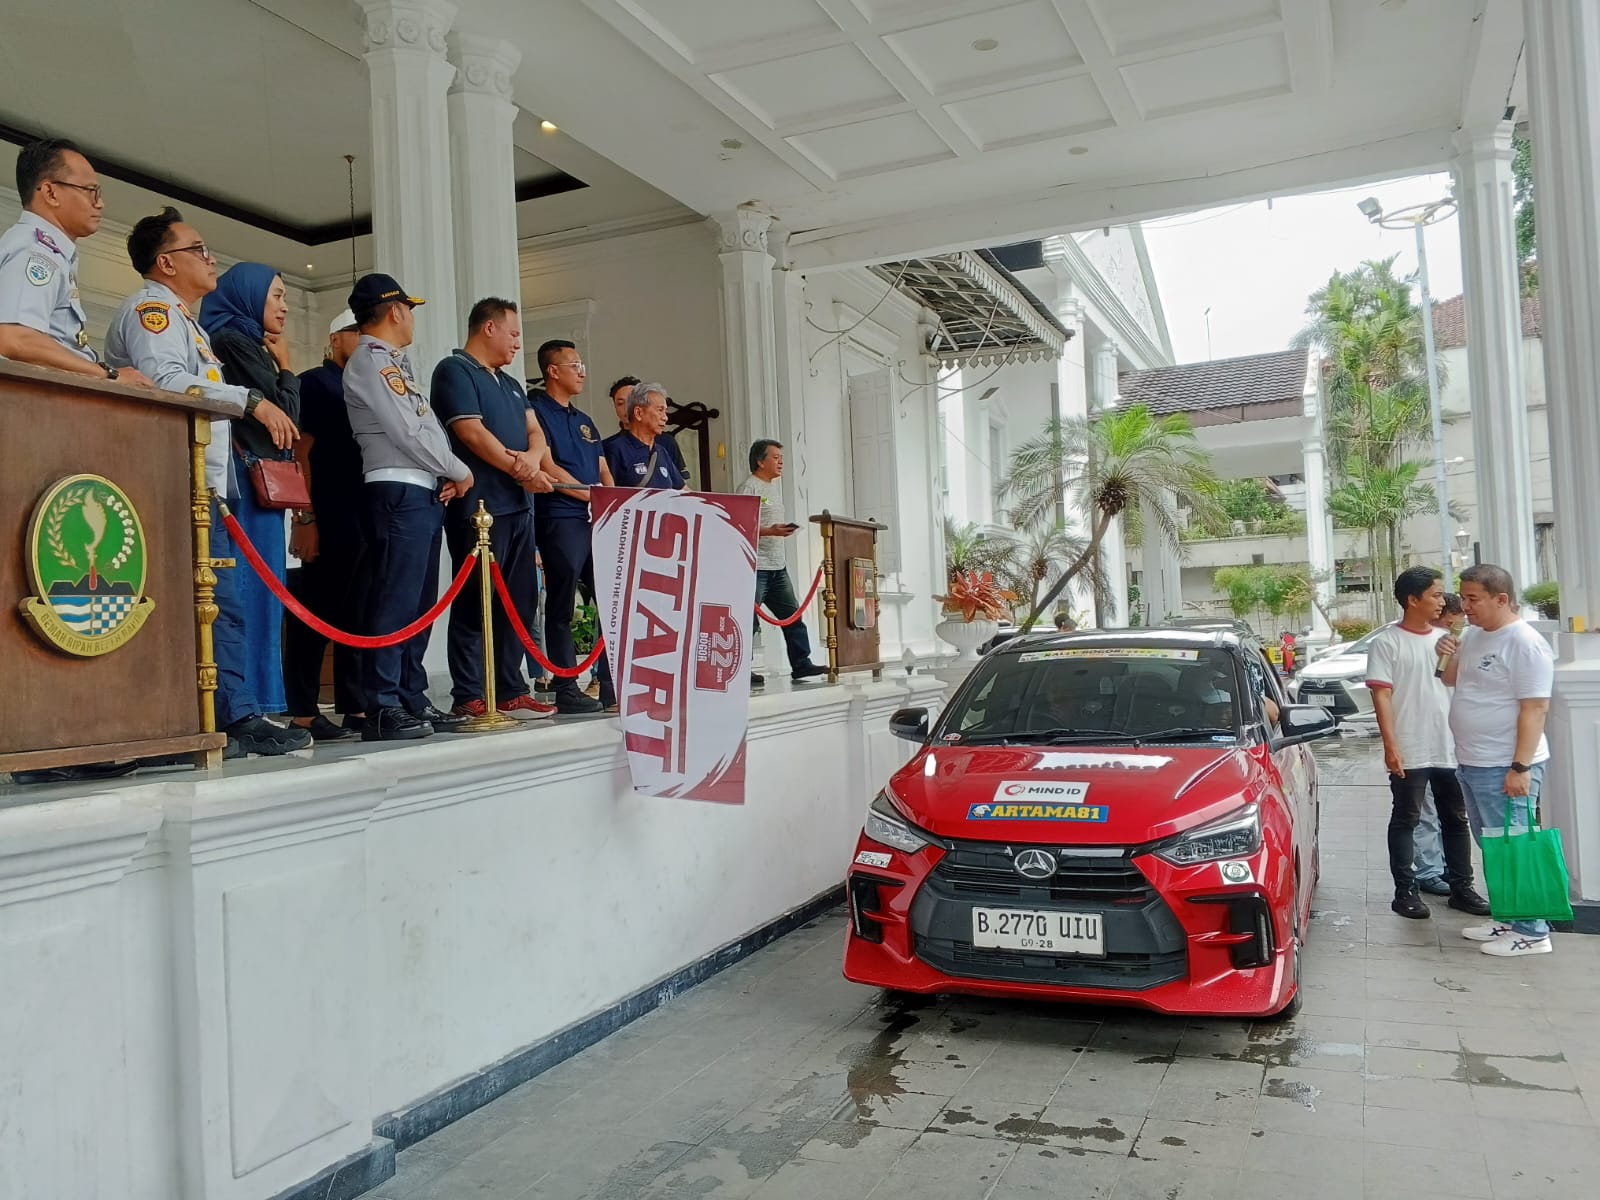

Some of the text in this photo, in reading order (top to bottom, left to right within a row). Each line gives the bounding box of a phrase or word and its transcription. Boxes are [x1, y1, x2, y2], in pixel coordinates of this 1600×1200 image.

[617, 508, 631, 564] RAMADHAN
[615, 565, 623, 580] ON
[613, 582, 621, 599] THE
[610, 600, 619, 628] ROAD
[66, 639, 93, 652] RIPAH
[609, 640, 615, 651] 22
[625, 510, 689, 773] START
[697, 632, 709, 662] BOGOR
[711, 632, 734, 668] 22
[1028, 787, 1064, 795] MIND
[991, 805, 1100, 819] ARTAMA81
[1059, 916, 1097, 940] UIU
